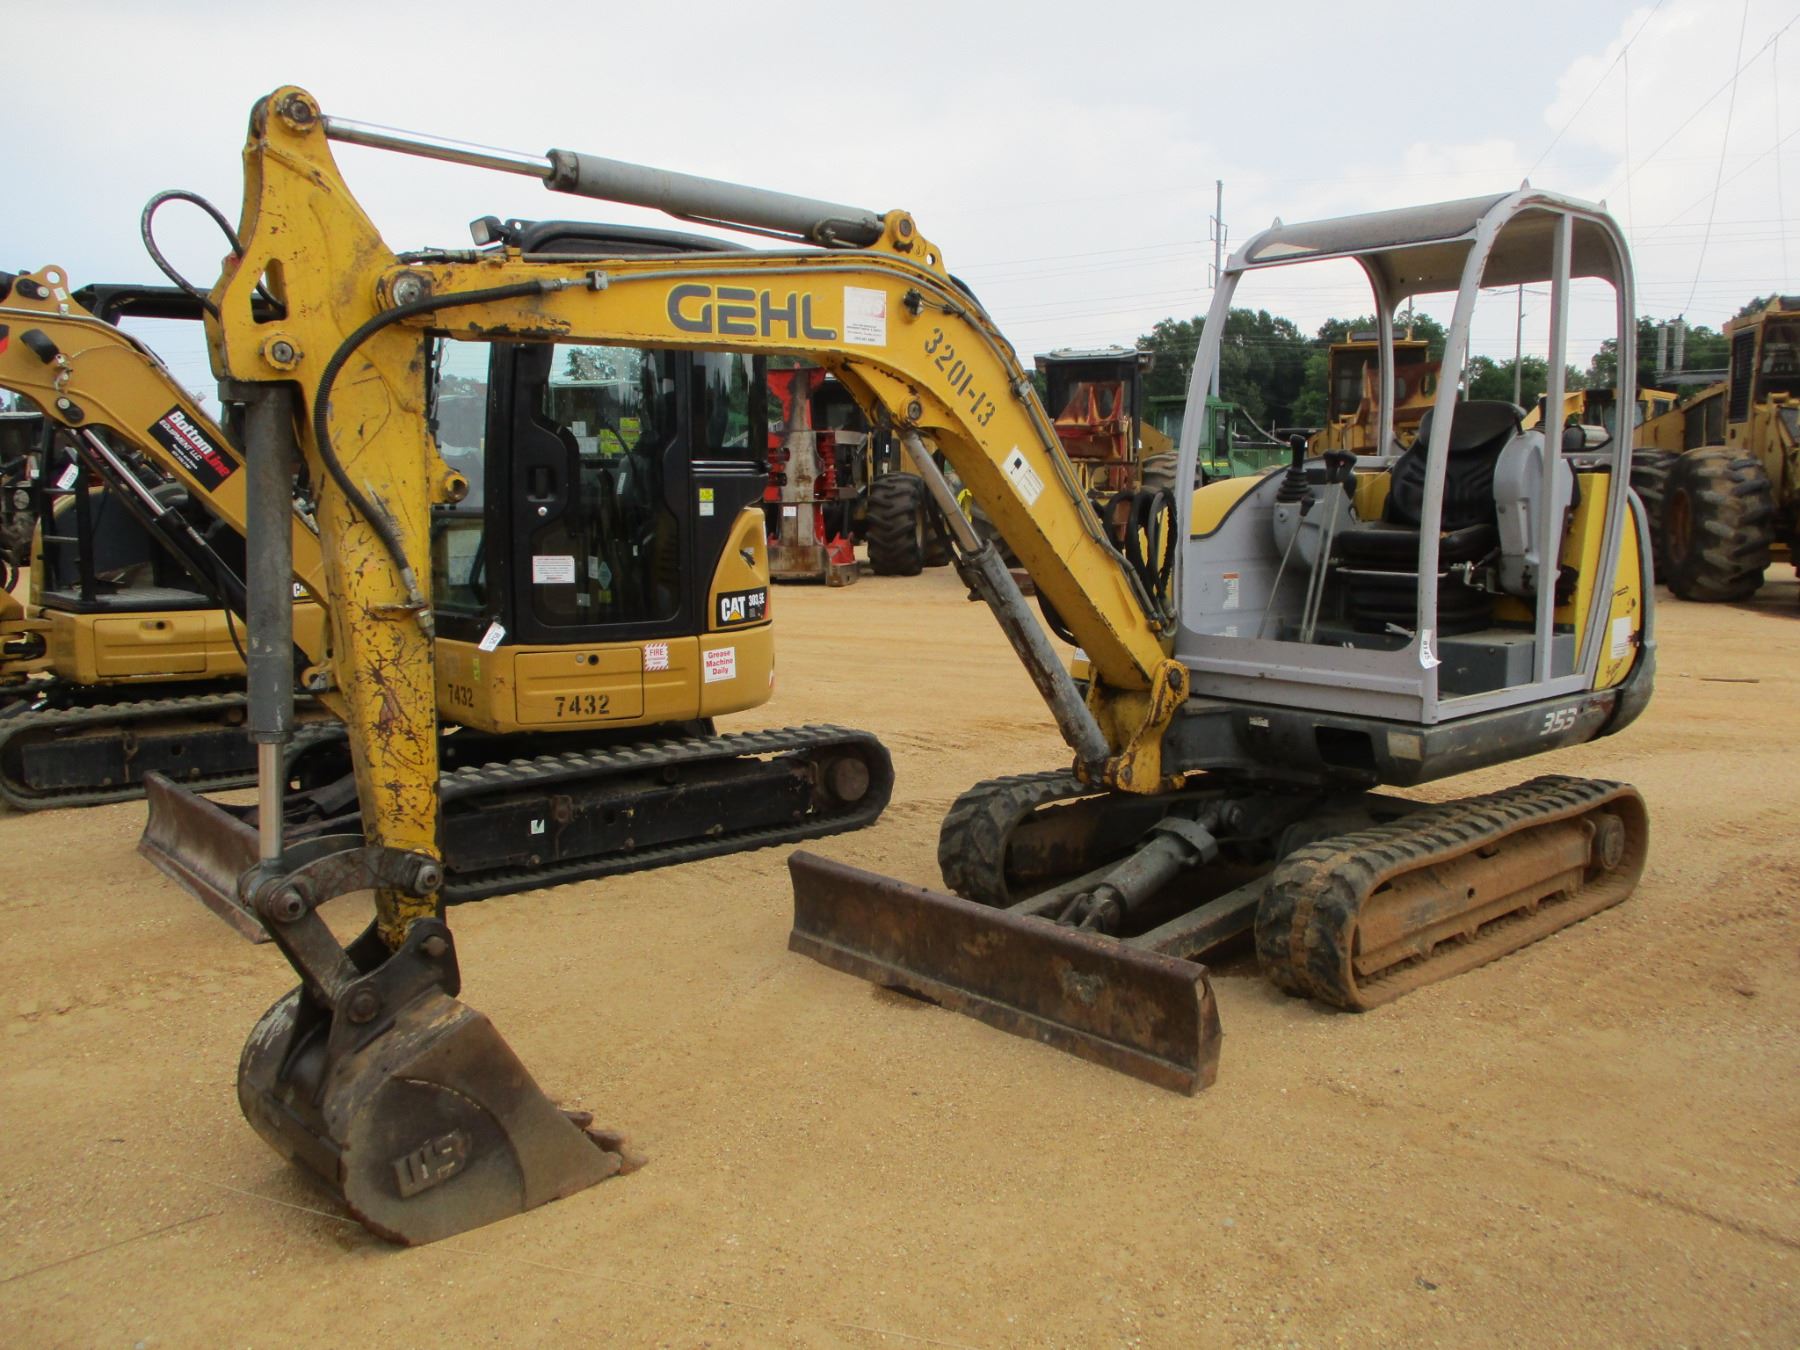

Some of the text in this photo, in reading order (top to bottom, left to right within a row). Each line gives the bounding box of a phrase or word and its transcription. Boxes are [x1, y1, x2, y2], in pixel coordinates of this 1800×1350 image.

[666, 282, 838, 341] GEHL
[924, 327, 996, 428] 3201-13
[159, 419, 194, 452] EQUIPMENT
[189, 446, 203, 461] LLC
[720, 596, 746, 622] CAT
[649, 648, 664, 657] FIRE
[706, 658, 734, 668] Machine
[707, 650, 731, 659] Grease
[712, 667, 729, 676] Daily
[447, 683, 475, 708] 7432
[554, 694, 611, 718] 7432
[1539, 707, 1578, 736] 353
